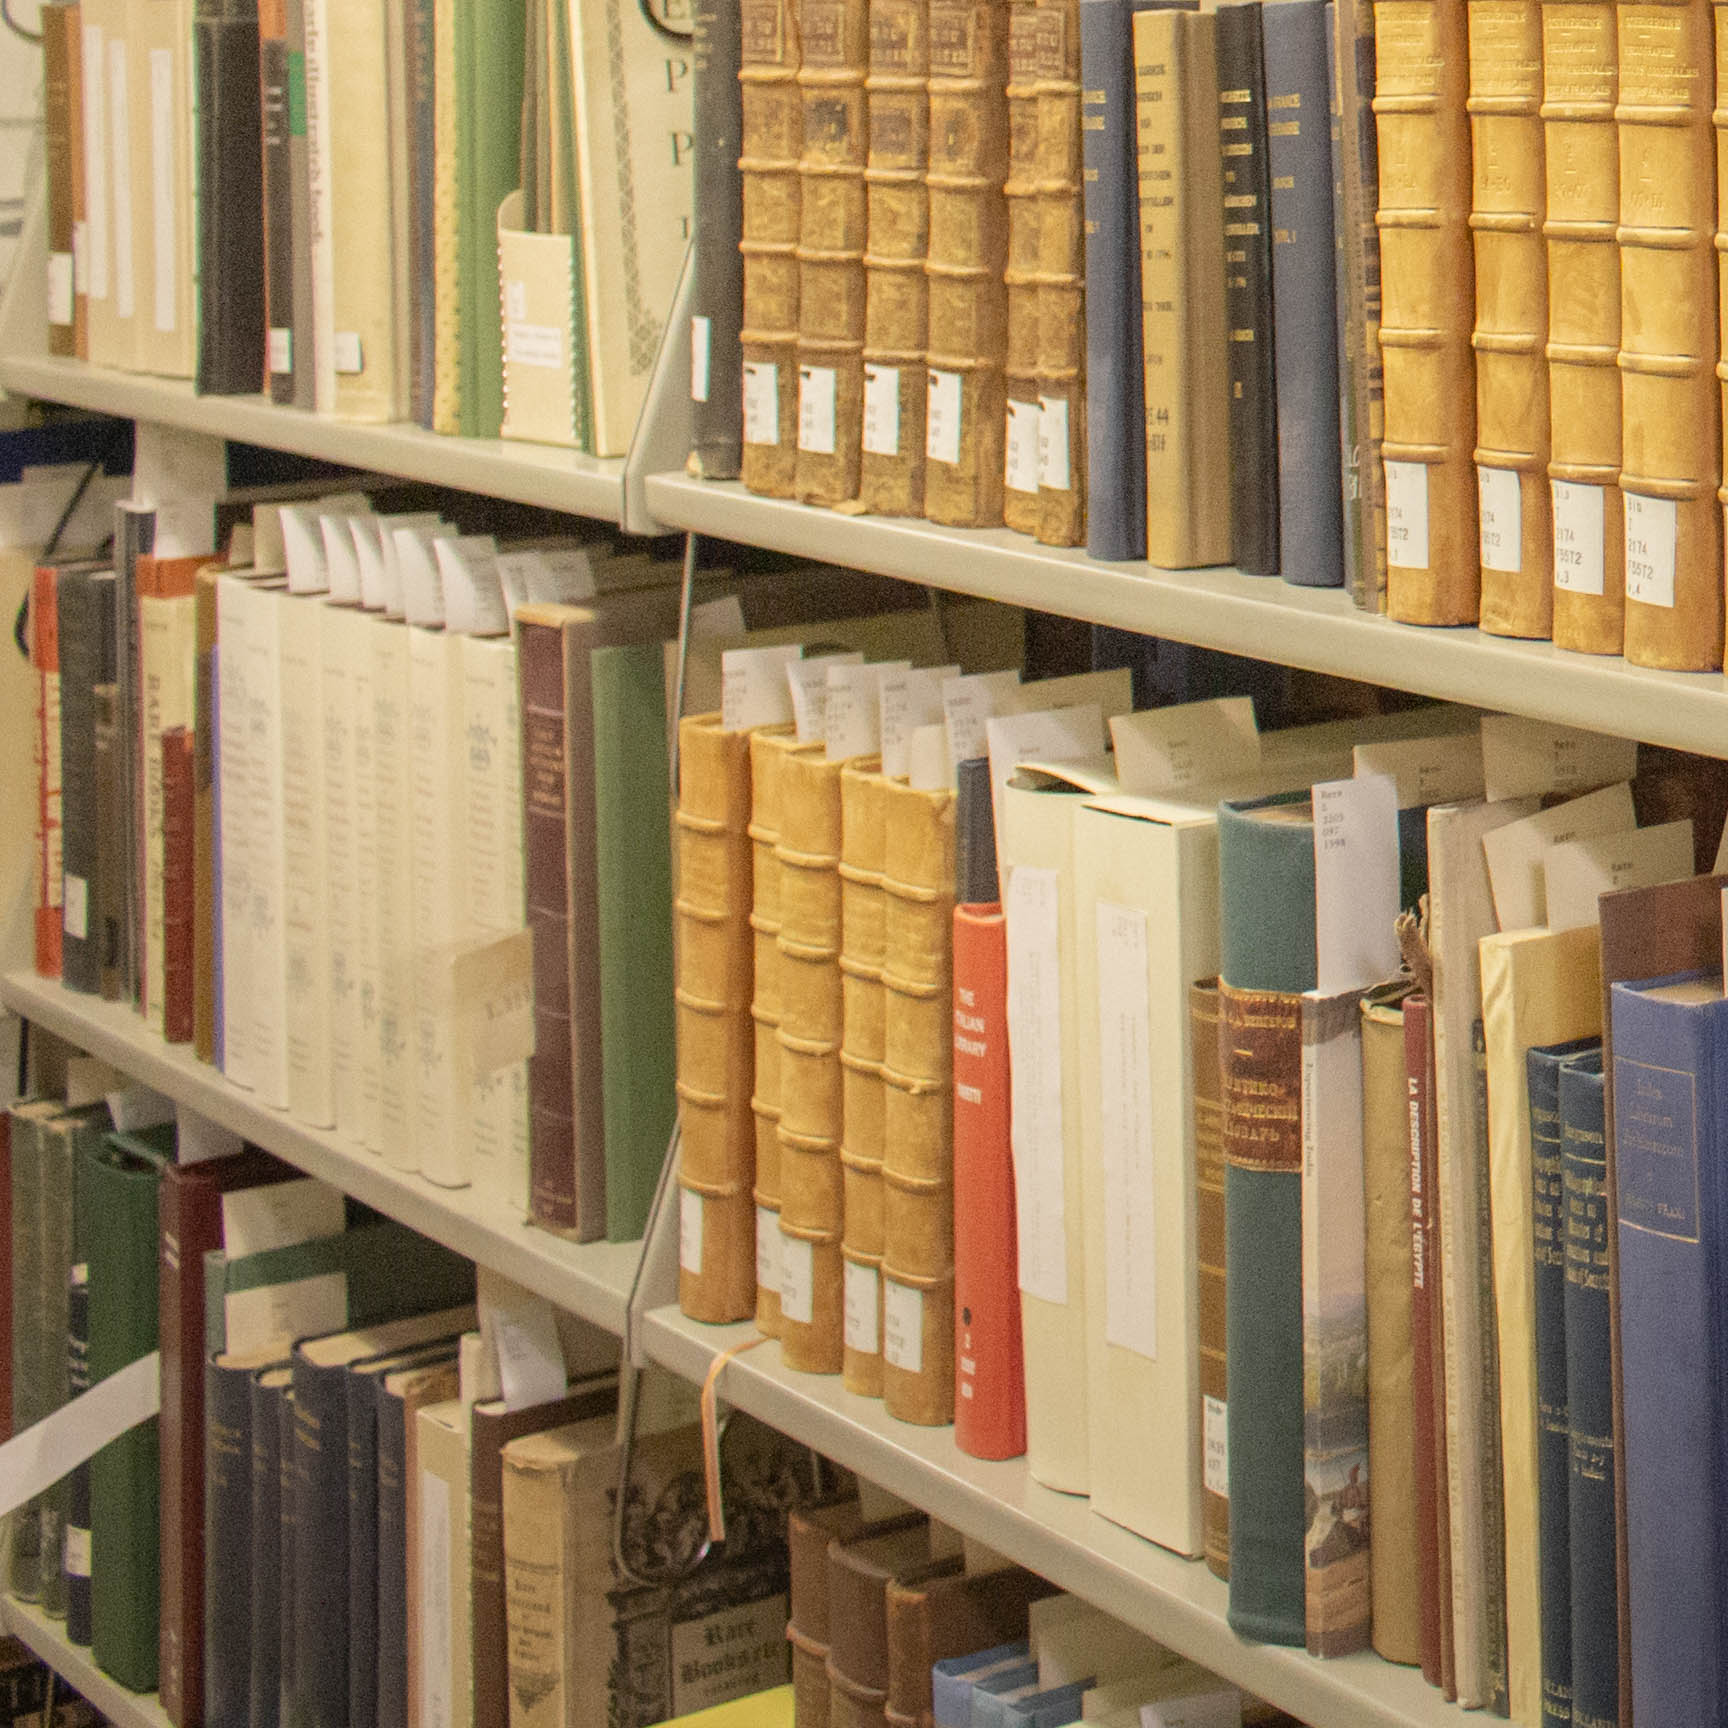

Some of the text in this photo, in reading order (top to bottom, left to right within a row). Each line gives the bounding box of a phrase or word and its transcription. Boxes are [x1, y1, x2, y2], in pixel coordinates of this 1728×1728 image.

[1408, 1077, 1418, 1095] LA
[1409, 1100, 1422, 1193] DESCRIPTION
[1412, 1197, 1423, 1218] DE
